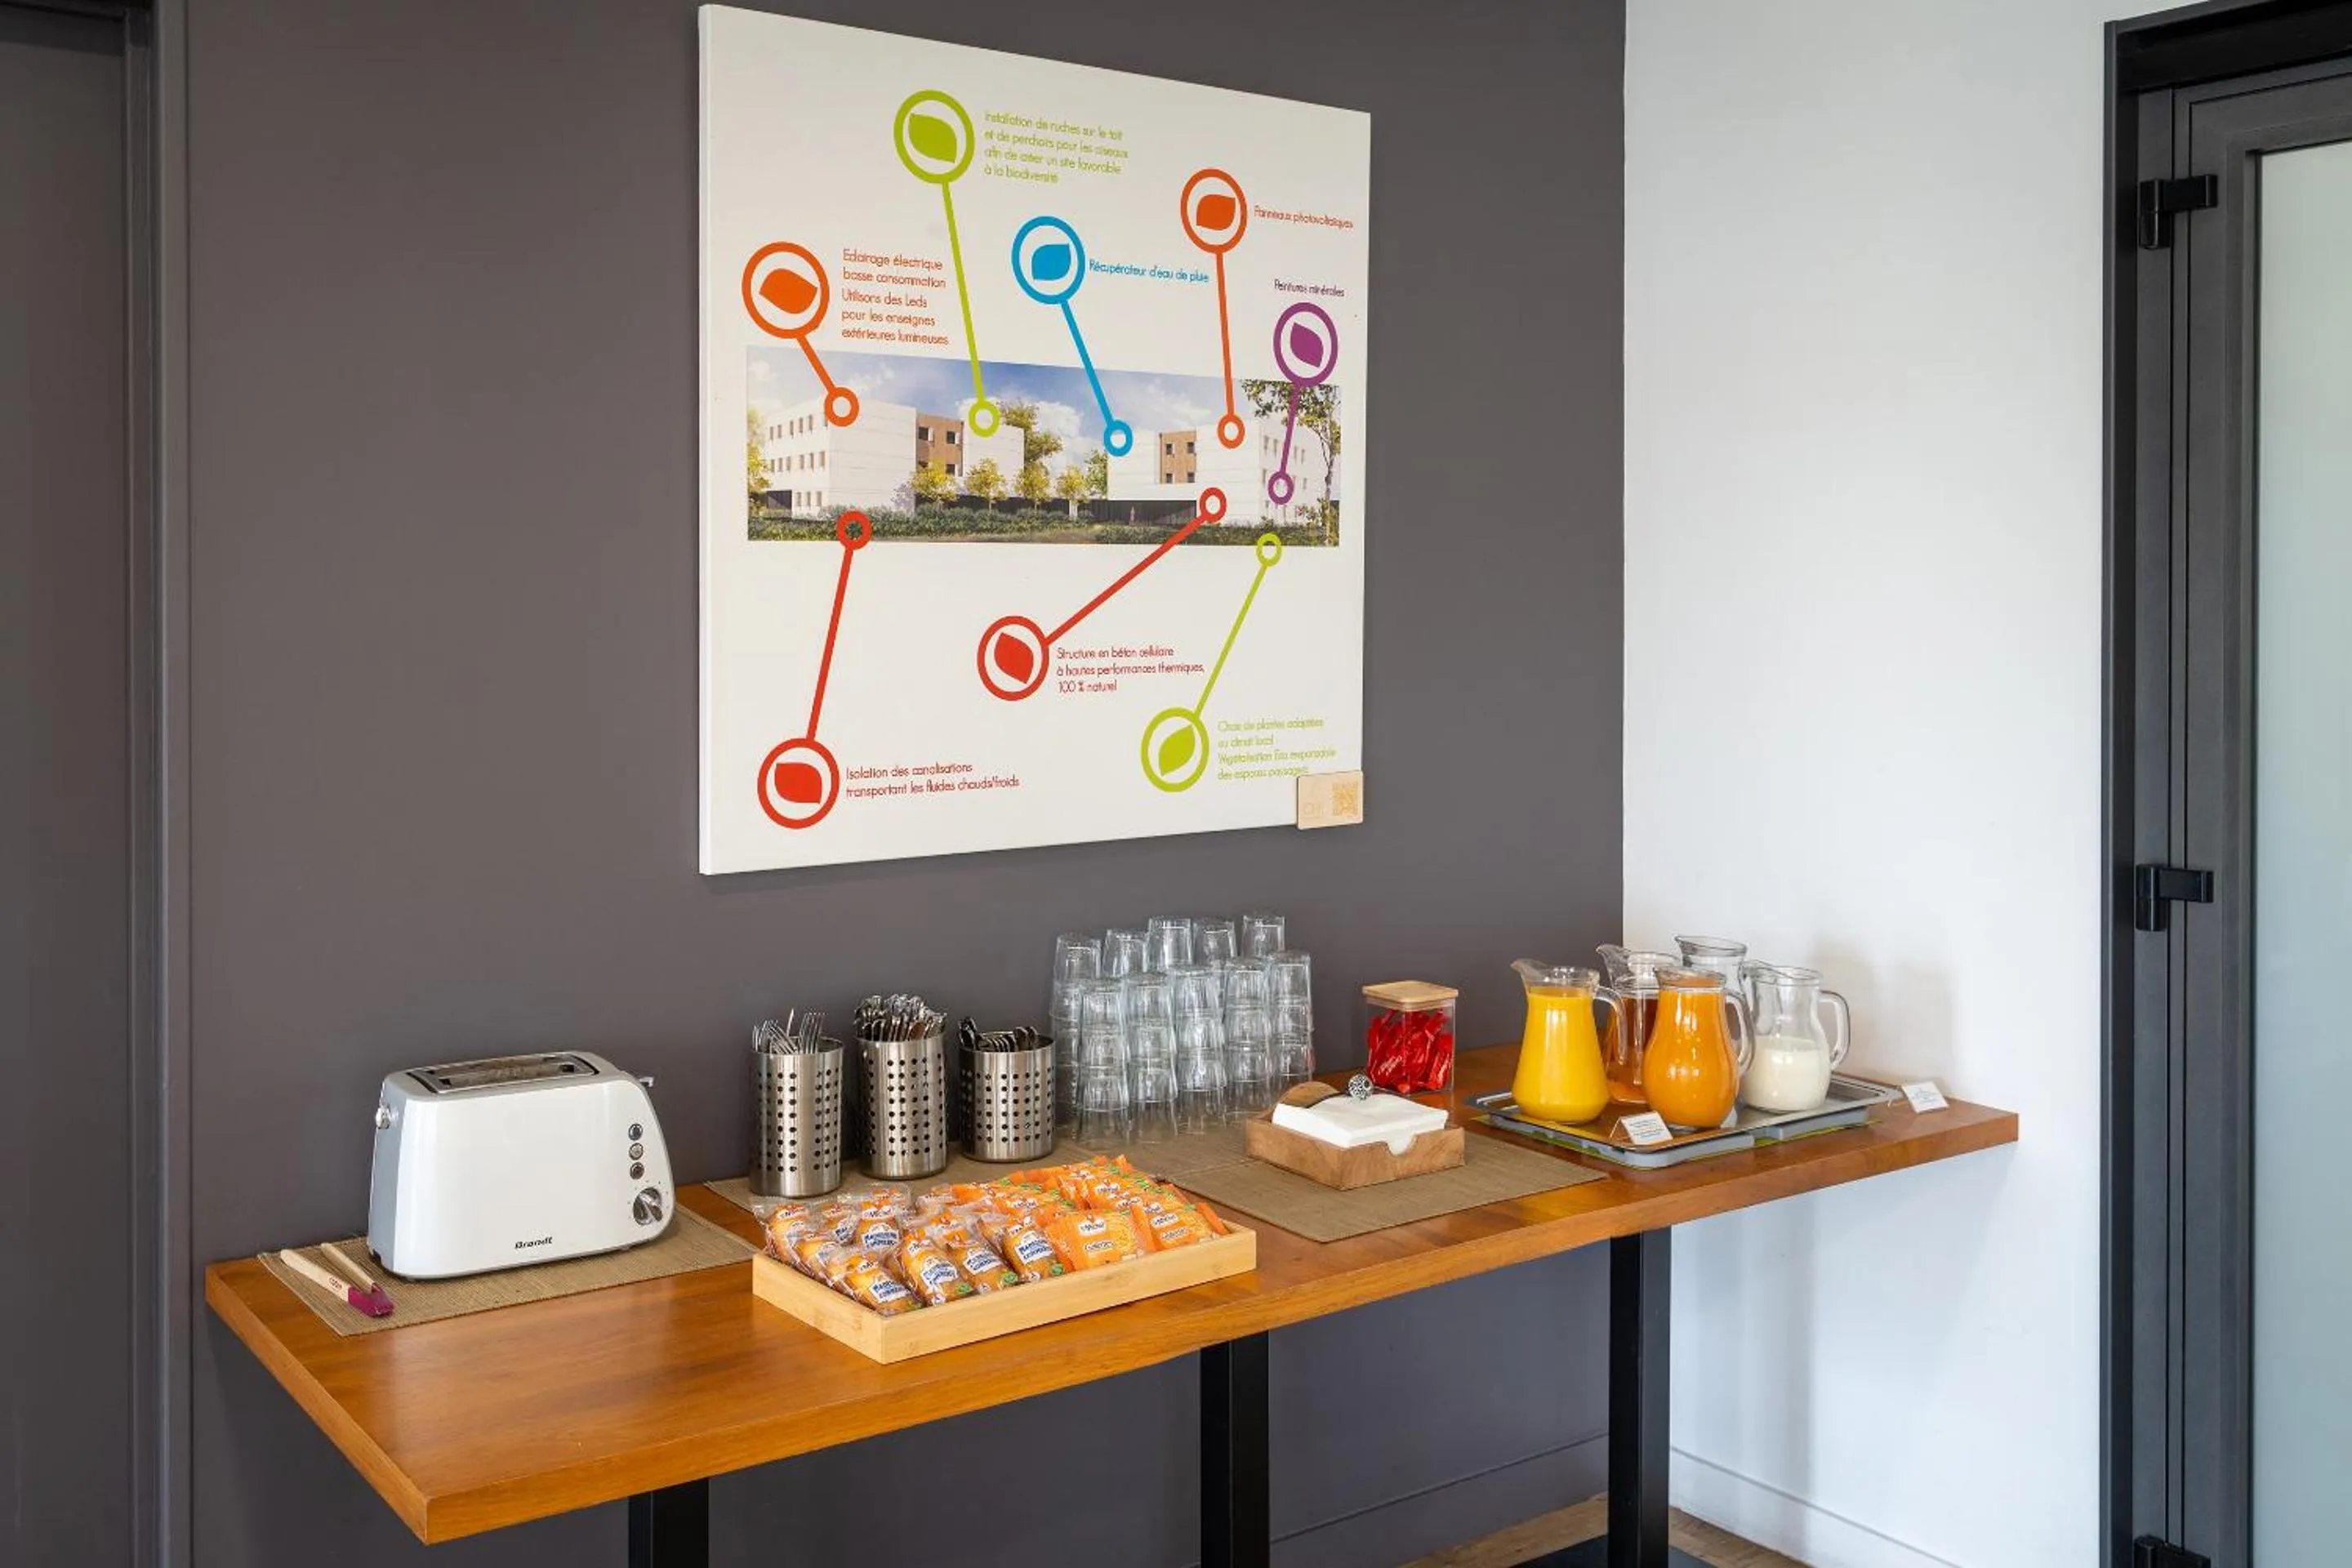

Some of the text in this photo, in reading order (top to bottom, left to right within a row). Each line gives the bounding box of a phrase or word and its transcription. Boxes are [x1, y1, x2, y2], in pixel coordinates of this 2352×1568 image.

[1036, 118, 1049, 129] de
[984, 129, 993, 140] et
[996, 130, 1009, 141] de
[1057, 140, 1077, 152] pour
[1080, 140, 1093, 153] les
[1004, 147, 1018, 160] de
[893, 254, 942, 272] électrique
[843, 267, 947, 288] basse consommation
[1176, 268, 1187, 280] de
[841, 288, 881, 304] Utilisons
[884, 292, 902, 305] des
[841, 308, 936, 327] pour les enseignes
[898, 329, 950, 345] lumineuses
[1057, 647, 1096, 660] Structure
[1098, 649, 1109, 658] en
[1111, 646, 1138, 658] béton
[1057, 666, 1064, 677] à
[1097, 662, 1156, 678] performances
[1058, 679, 1076, 693] 100
[1087, 679, 1117, 693] naturel
[846, 765, 889, 781] Isolation
[890, 764, 910, 778] des
[846, 783, 907, 800] transportant
[911, 781, 924, 795] les
[926, 778, 956, 794] fluides
[514, 1236, 553, 1250] Brandt
